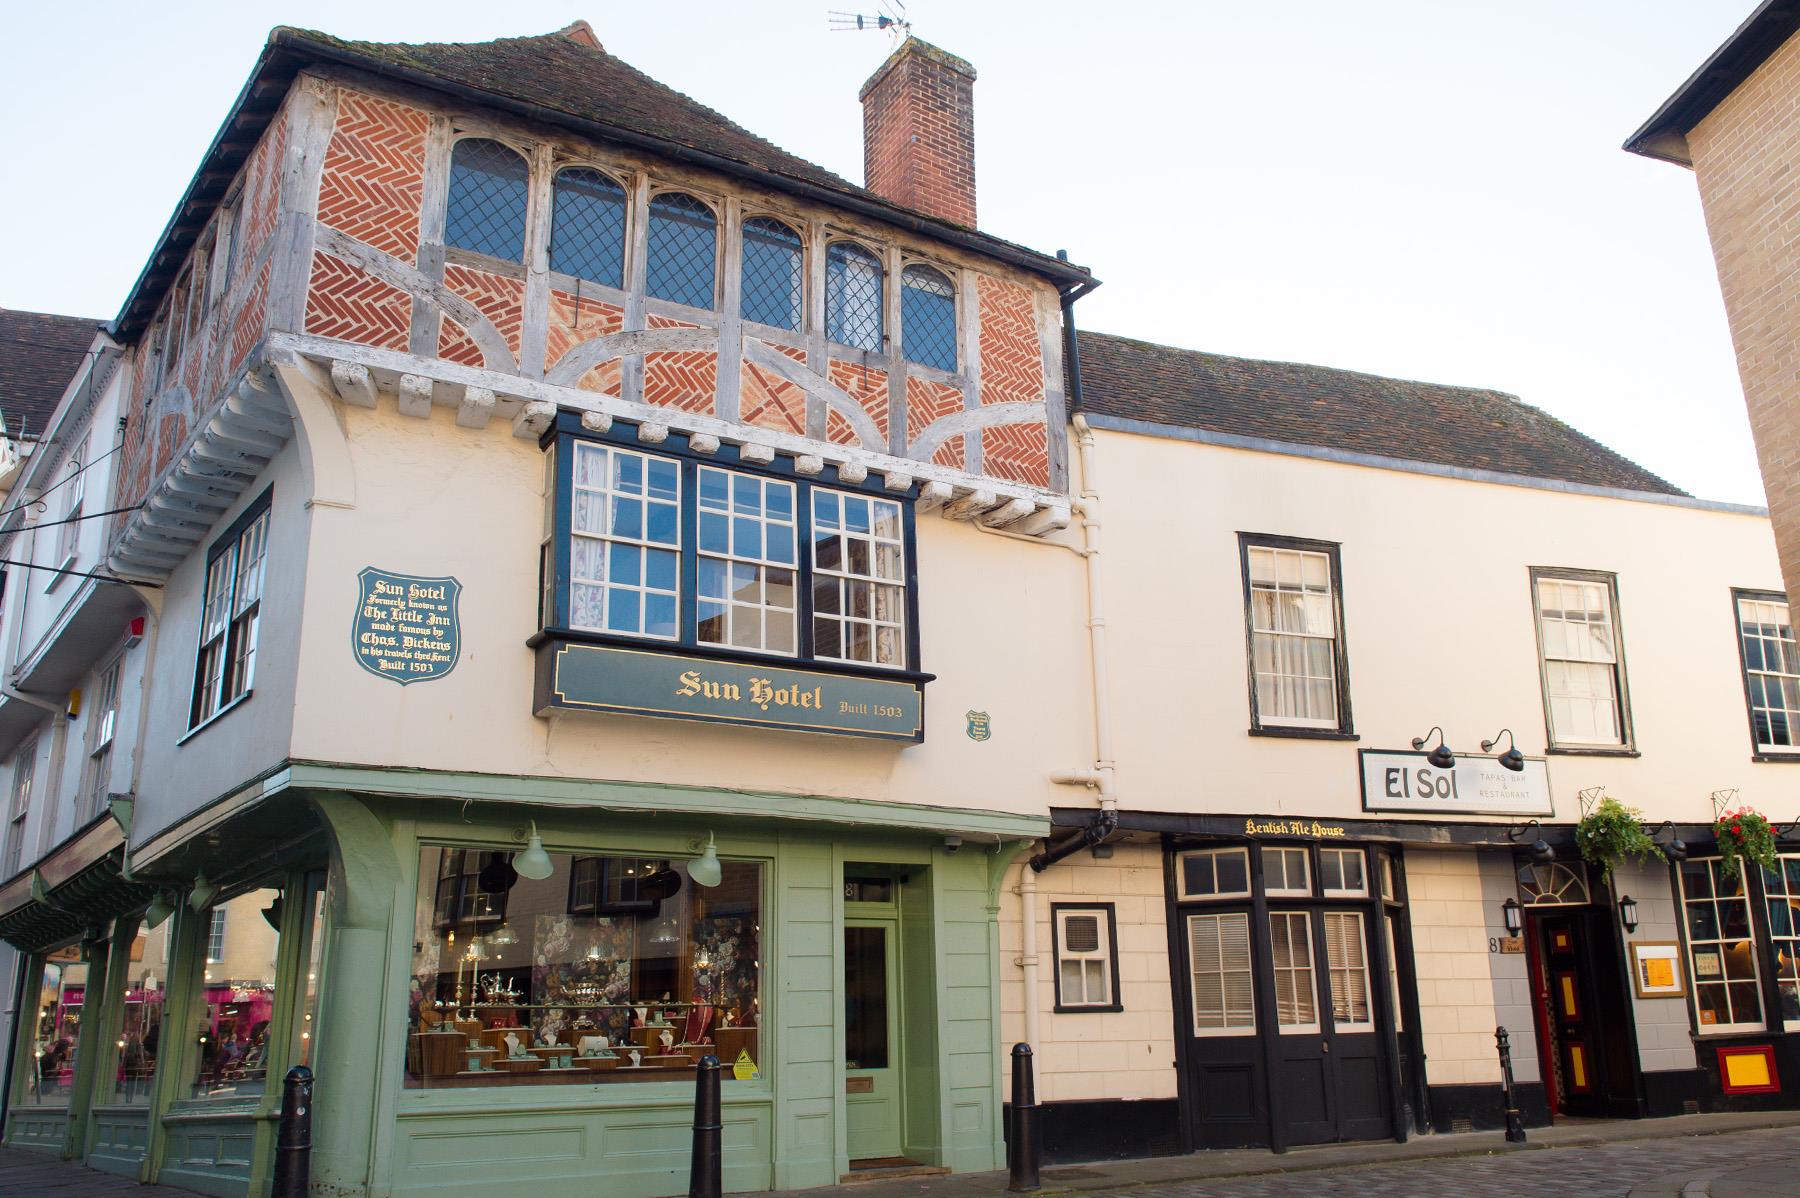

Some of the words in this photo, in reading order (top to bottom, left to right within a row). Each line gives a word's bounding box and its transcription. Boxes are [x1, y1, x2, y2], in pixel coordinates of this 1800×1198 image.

[373, 580, 404, 596] Sun
[408, 583, 446, 601] Hotel
[367, 594, 406, 610] Formerly
[408, 600, 435, 610] known
[437, 603, 448, 612] as
[363, 605, 387, 621] The
[390, 607, 423, 622] Little
[425, 612, 451, 626] Inn
[371, 622, 396, 632] made
[398, 623, 431, 636] famous
[432, 627, 444, 640] by
[361, 632, 399, 647] Chas.
[402, 635, 452, 651] Dickens
[361, 646, 370, 655] in
[370, 647, 383, 657] his
[384, 649, 413, 660] travels
[430, 652, 451, 662] Kent
[378, 658, 406, 671] Built
[409, 662, 434, 673] 1503
[675, 670, 742, 702] Sun
[747, 677, 824, 711] Hotel
[838, 701, 868, 716] Built
[872, 704, 903, 719] 1503
[1385, 767, 1411, 799] El
[1416, 768, 1459, 800] Sol
[1479, 773, 1507, 782] TAPAS
[1511, 774, 1527, 783] BAR
[1479, 790, 1531, 799] RESTAURANT
[1245, 818, 1289, 835] Kentish
[1290, 820, 1311, 836] Ale
[1311, 820, 1346, 838] House
[1489, 937, 1498, 953] 8
